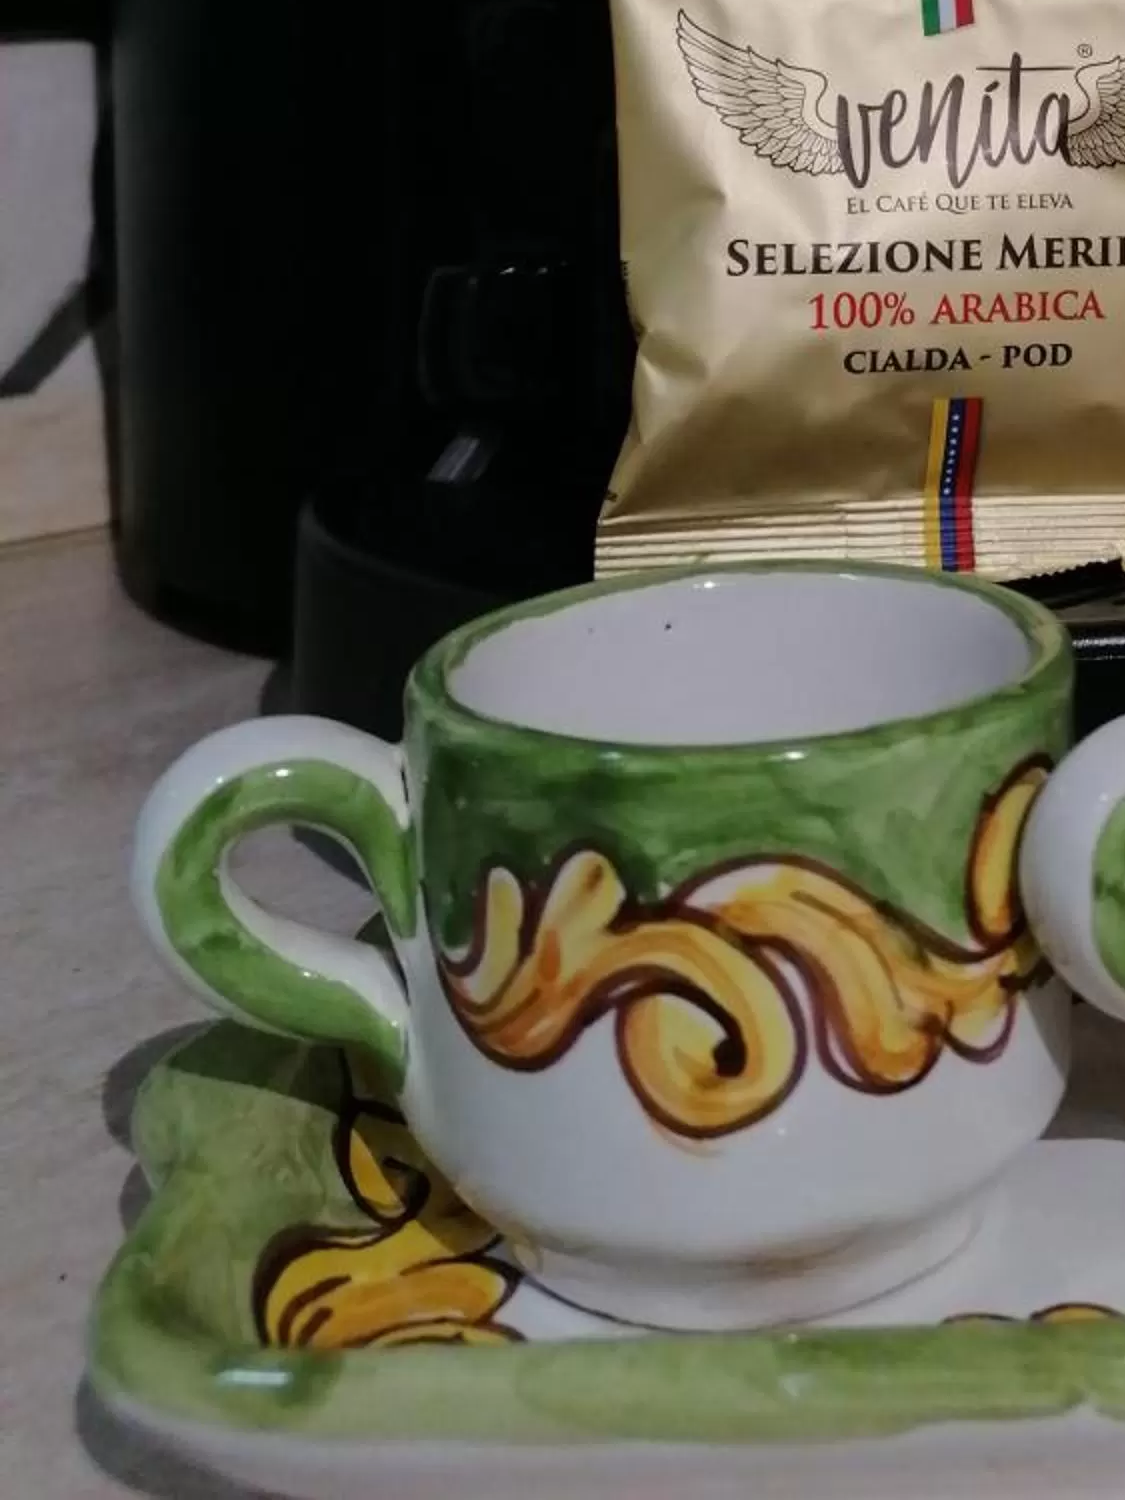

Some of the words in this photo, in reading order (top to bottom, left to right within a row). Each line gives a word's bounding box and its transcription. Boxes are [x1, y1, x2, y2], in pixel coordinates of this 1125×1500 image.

[846, 195, 870, 214] EL
[875, 193, 930, 213] CAFÉ
[934, 192, 981, 214] QUE
[987, 193, 1011, 210] TE
[1017, 192, 1074, 209] ELEVA
[725, 236, 983, 278] SELEZIONE
[808, 290, 917, 331] 100%
[928, 289, 1105, 326] ARABICA
[843, 346, 972, 375] CIALDA
[1003, 343, 1074, 369] POD
